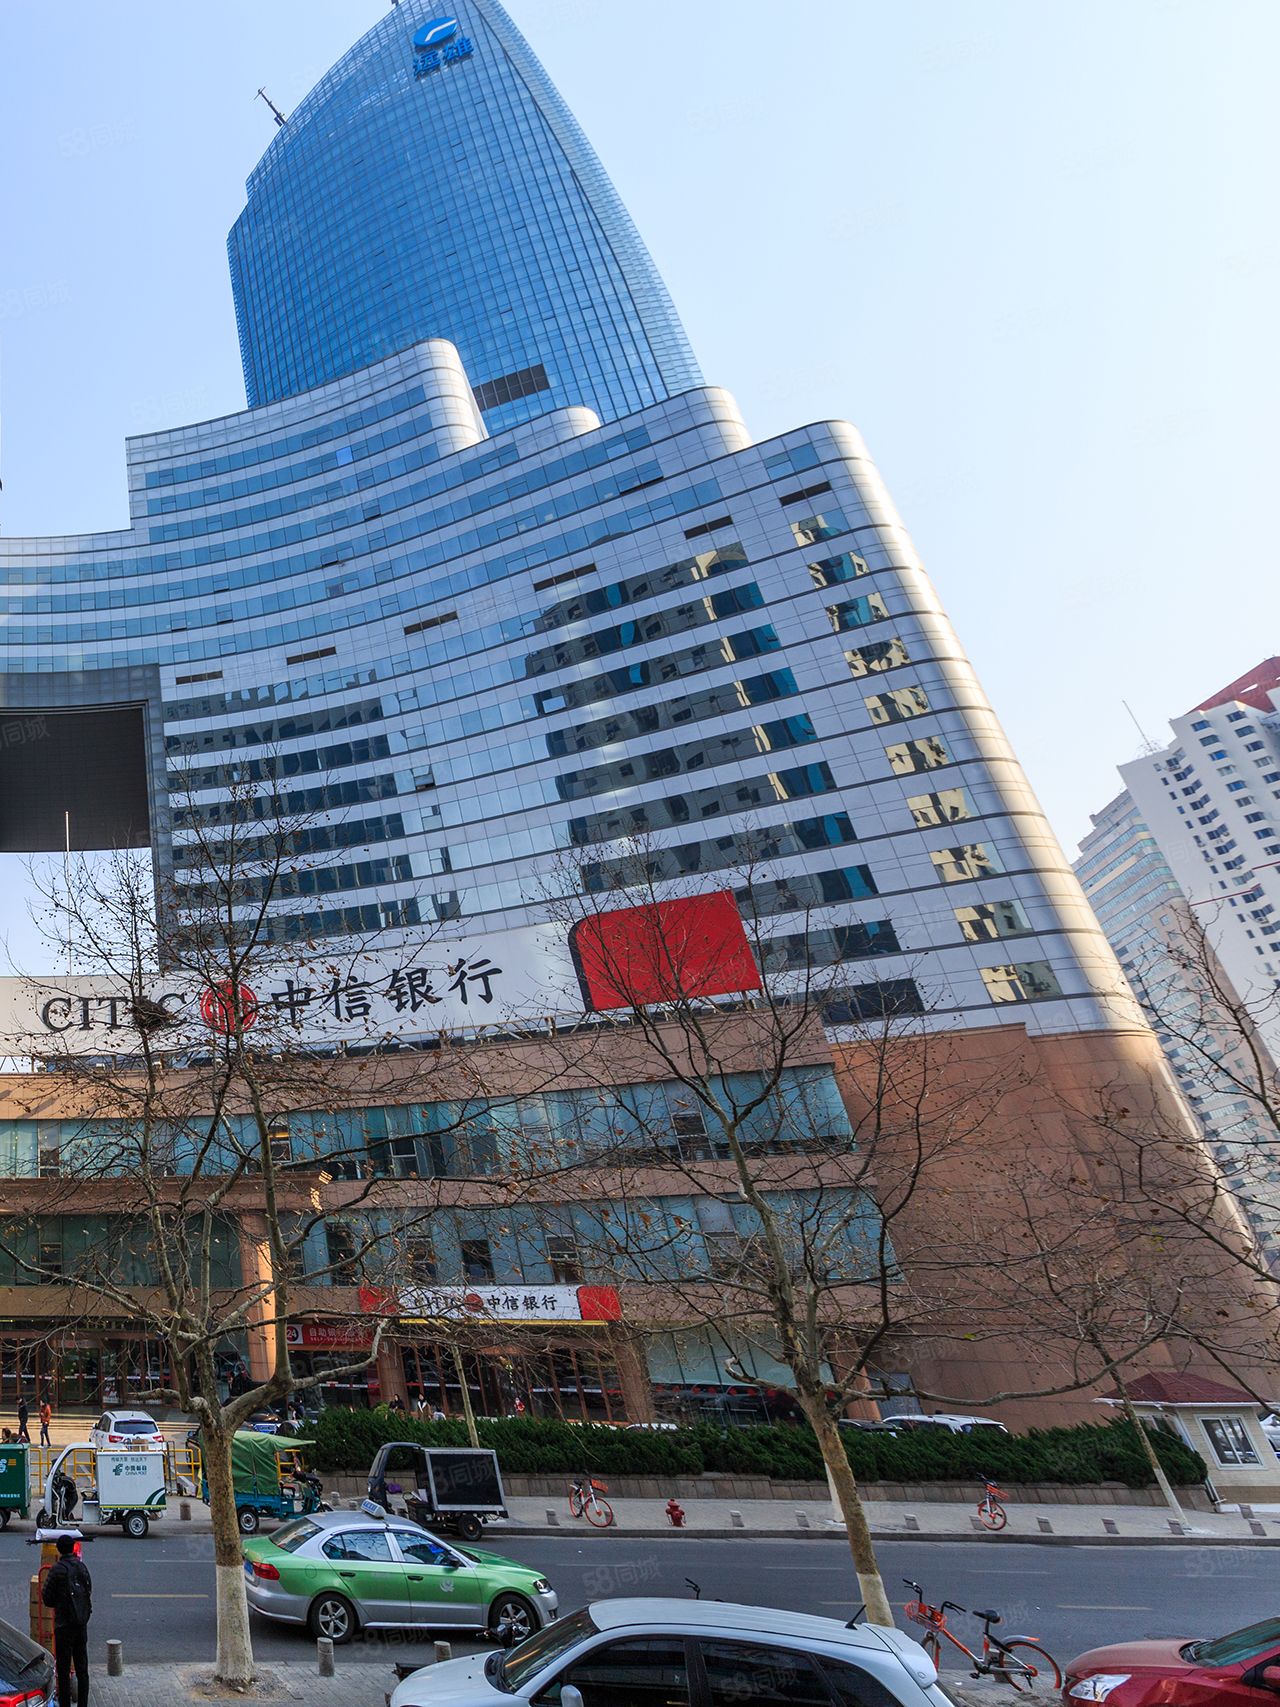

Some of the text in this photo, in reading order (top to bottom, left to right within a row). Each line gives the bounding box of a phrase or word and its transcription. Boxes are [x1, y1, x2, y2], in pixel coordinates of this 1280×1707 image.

[42, 992, 187, 1032] CITC
[271, 958, 502, 1027] 中信银行
[487, 1294, 558, 1311] 中信银行
